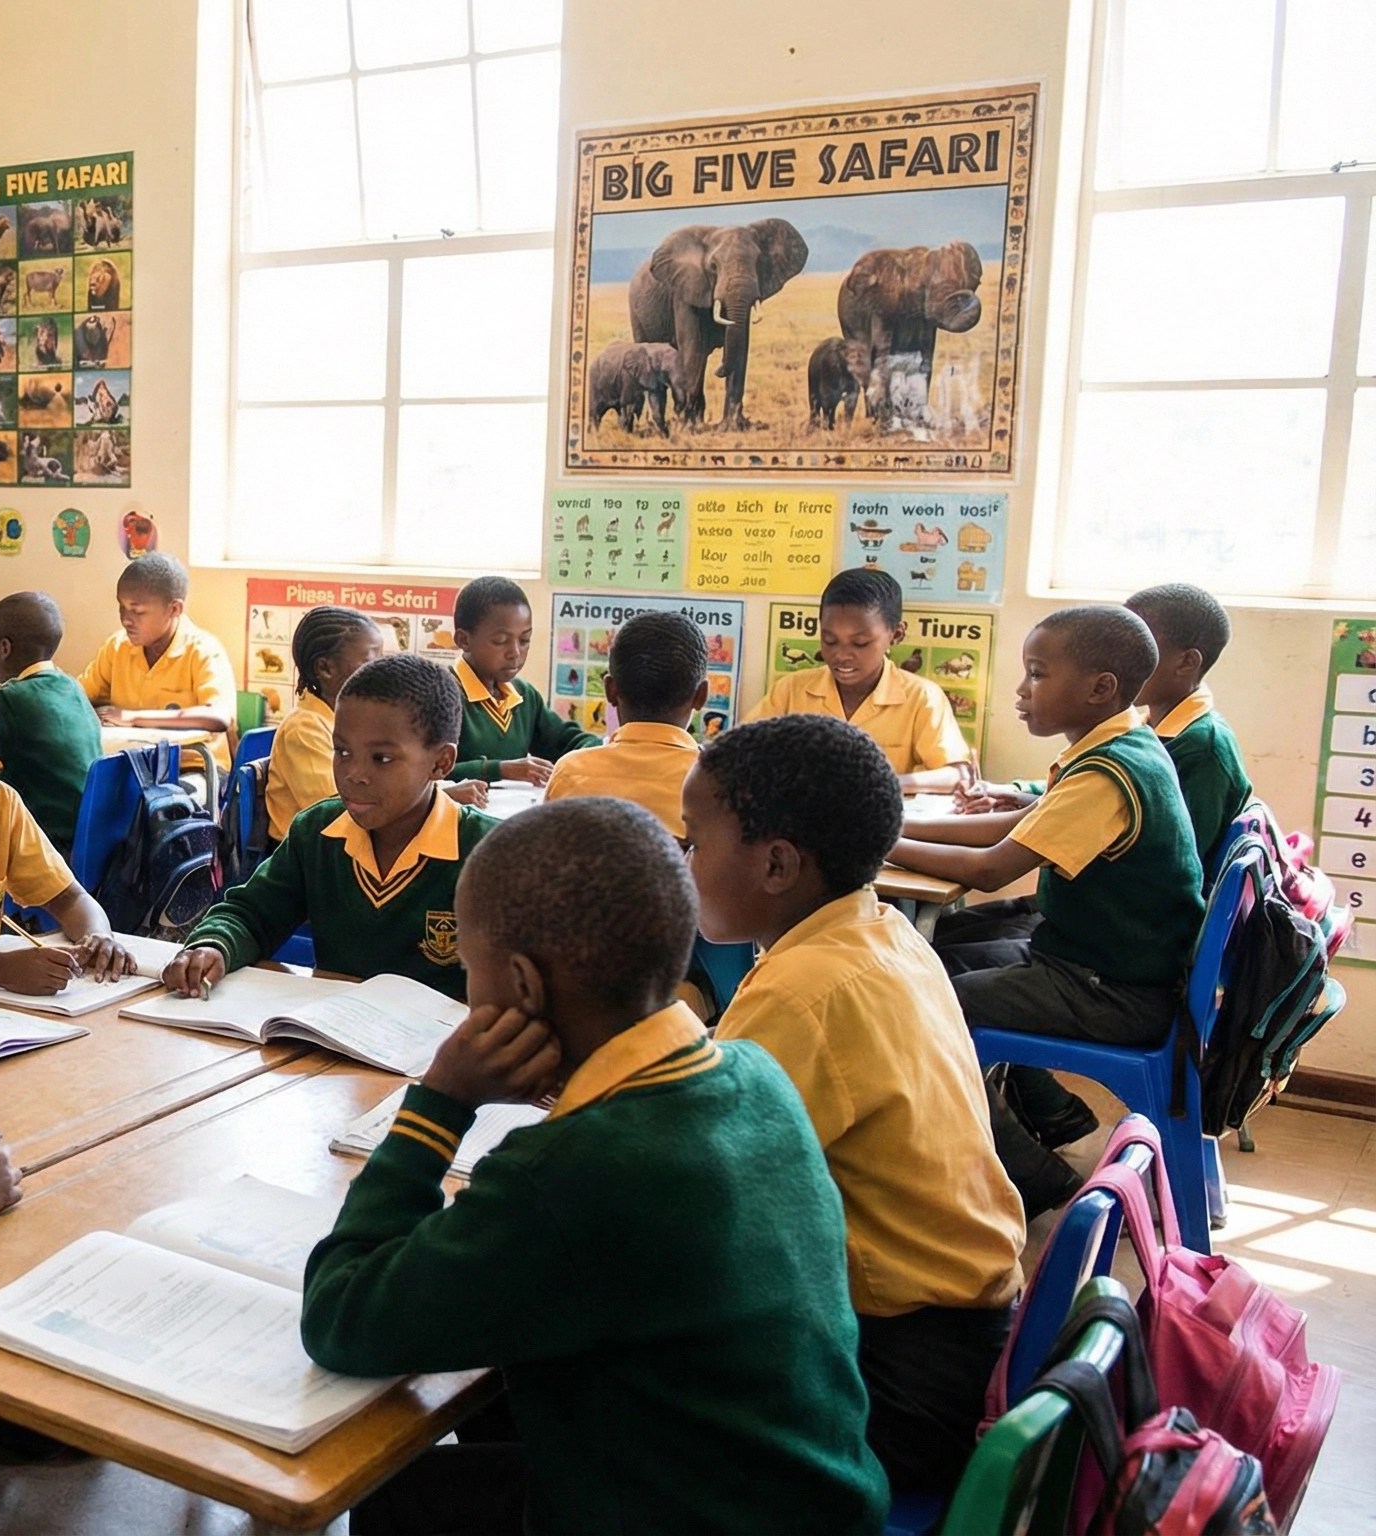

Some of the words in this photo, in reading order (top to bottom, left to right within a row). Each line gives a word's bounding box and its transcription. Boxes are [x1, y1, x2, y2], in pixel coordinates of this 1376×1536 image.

[602, 157, 673, 201] BIG
[693, 148, 796, 194] FIVE
[819, 131, 1000, 185] SAFARI
[6, 170, 49, 197] FIVE
[56, 160, 128, 191] SAFARI
[341, 587, 376, 606] Five
[382, 589, 438, 609] Safari
[779, 611, 818, 636] Big
[918, 618, 982, 640] Tiurs
[1360, 768, 1375, 787] 3
[1354, 807, 1372, 828] 4
[1351, 852, 1367, 868] e
